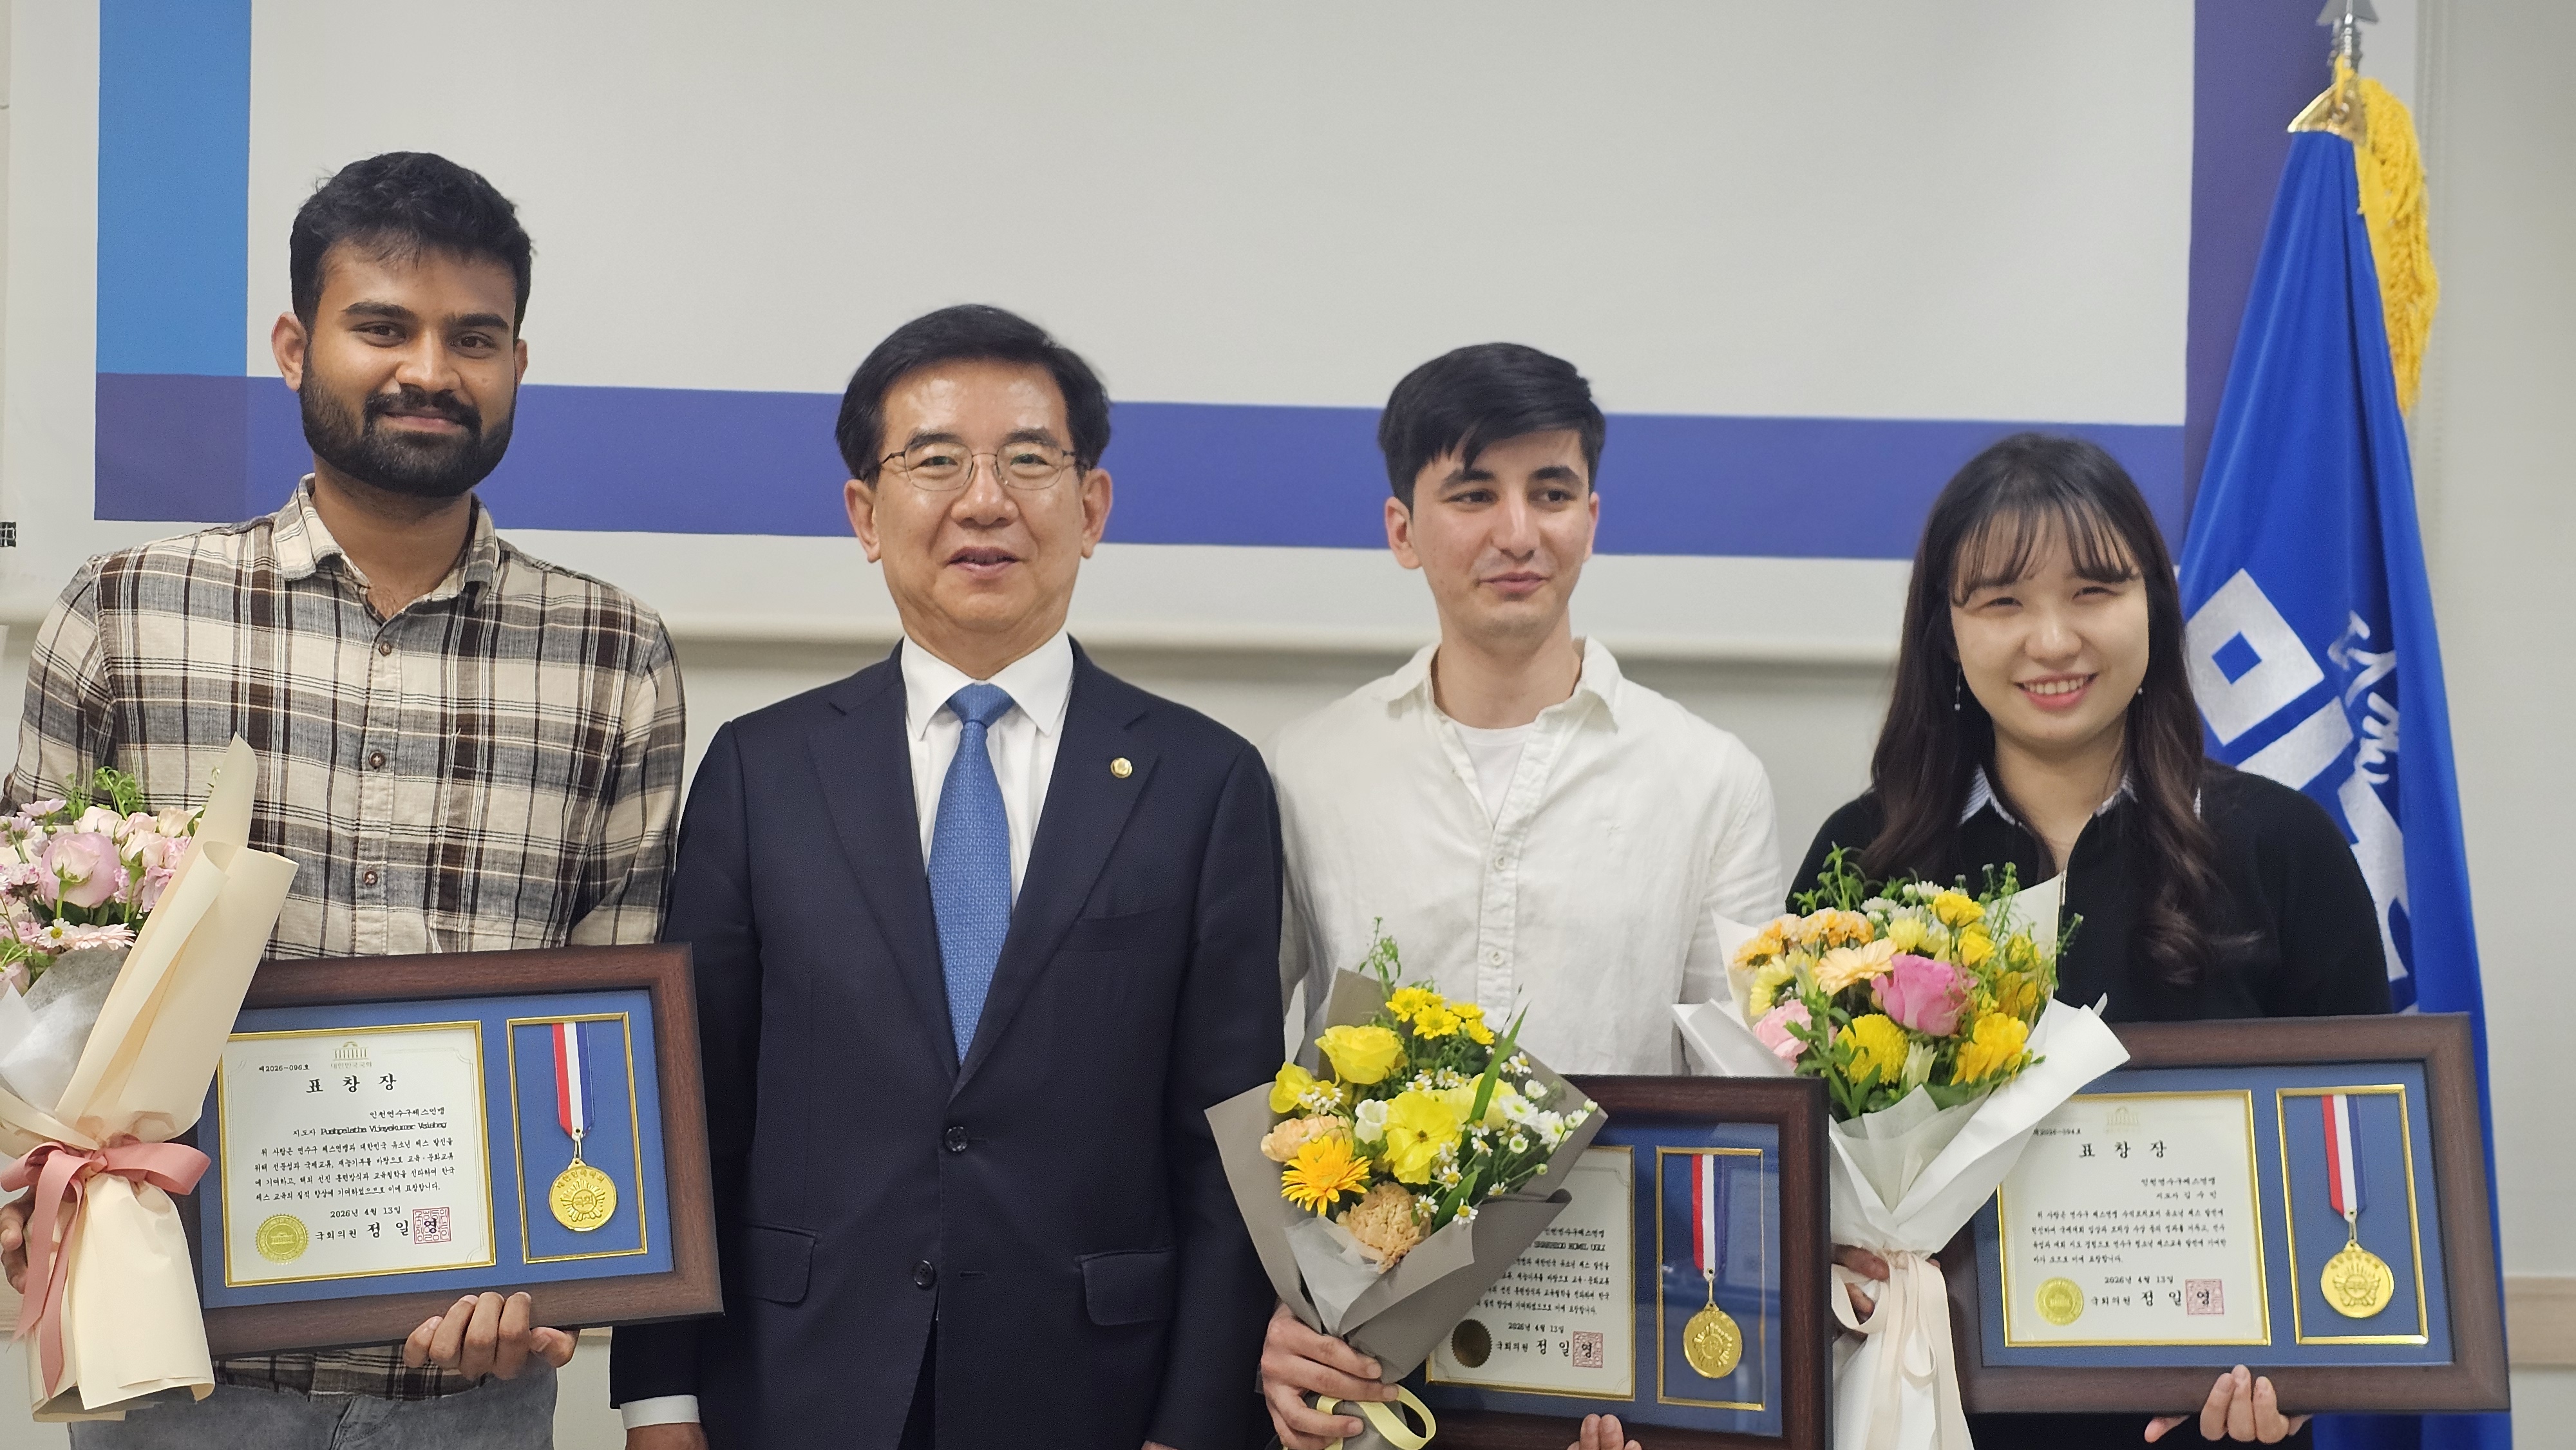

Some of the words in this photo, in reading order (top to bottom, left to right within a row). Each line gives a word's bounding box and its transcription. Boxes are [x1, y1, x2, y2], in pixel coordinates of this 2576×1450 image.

[370, 1106, 445, 1119] 인천연수구체스연맹
[293, 1128, 316, 1137] 지도자
[261, 1147, 267, 1157] 위
[272, 1147, 293, 1156] 사람은
[298, 1145, 317, 1155] 연수구
[322, 1144, 355, 1153] 체스연맹과
[360, 1142, 386, 1151] 대한민국
[391, 1140, 410, 1149] 유소년
[415, 1138, 429, 1148] 체스
[433, 1137, 453, 1146] 발전을
[254, 1163, 267, 1172] 위해
[273, 1162, 300, 1171] 전문성과
[338, 1158, 372, 1167] 재능기부를
[376, 1156, 403, 1165] 바탕으로
[254, 1178, 261, 1187] 에
[299, 1175, 313, 1185] 해외
[318, 1174, 330, 1183] 선진
[336, 1172, 369, 1182] 훈련방식과
[374, 1169, 406, 1180] 교육철학을
[412, 1167, 437, 1178] 전파하여
[442, 1166, 455, 1175] 한국
[256, 1192, 270, 1202] 체스
[273, 1191, 293, 1201] 교육의
[297, 1190, 310, 1200] 질적
[314, 1189, 334, 1198] 향상에
[338, 1186, 385, 1197] 기여하였으므로
[388, 1184, 401, 1194] 이에
[405, 1182, 440, 1192] 표창합니다.
[330, 1208, 359, 1218] 2026년
[364, 1207, 377, 1216] 4월
[383, 1205, 401, 1214] 13일
[315, 1229, 357, 1241] 국회의원
[2105, 1276, 2132, 1285] 2026년
[2137, 1276, 2150, 1285] 4월
[2157, 1275, 2174, 1285] 13일
[1508, 1322, 1531, 1332] 2026년
